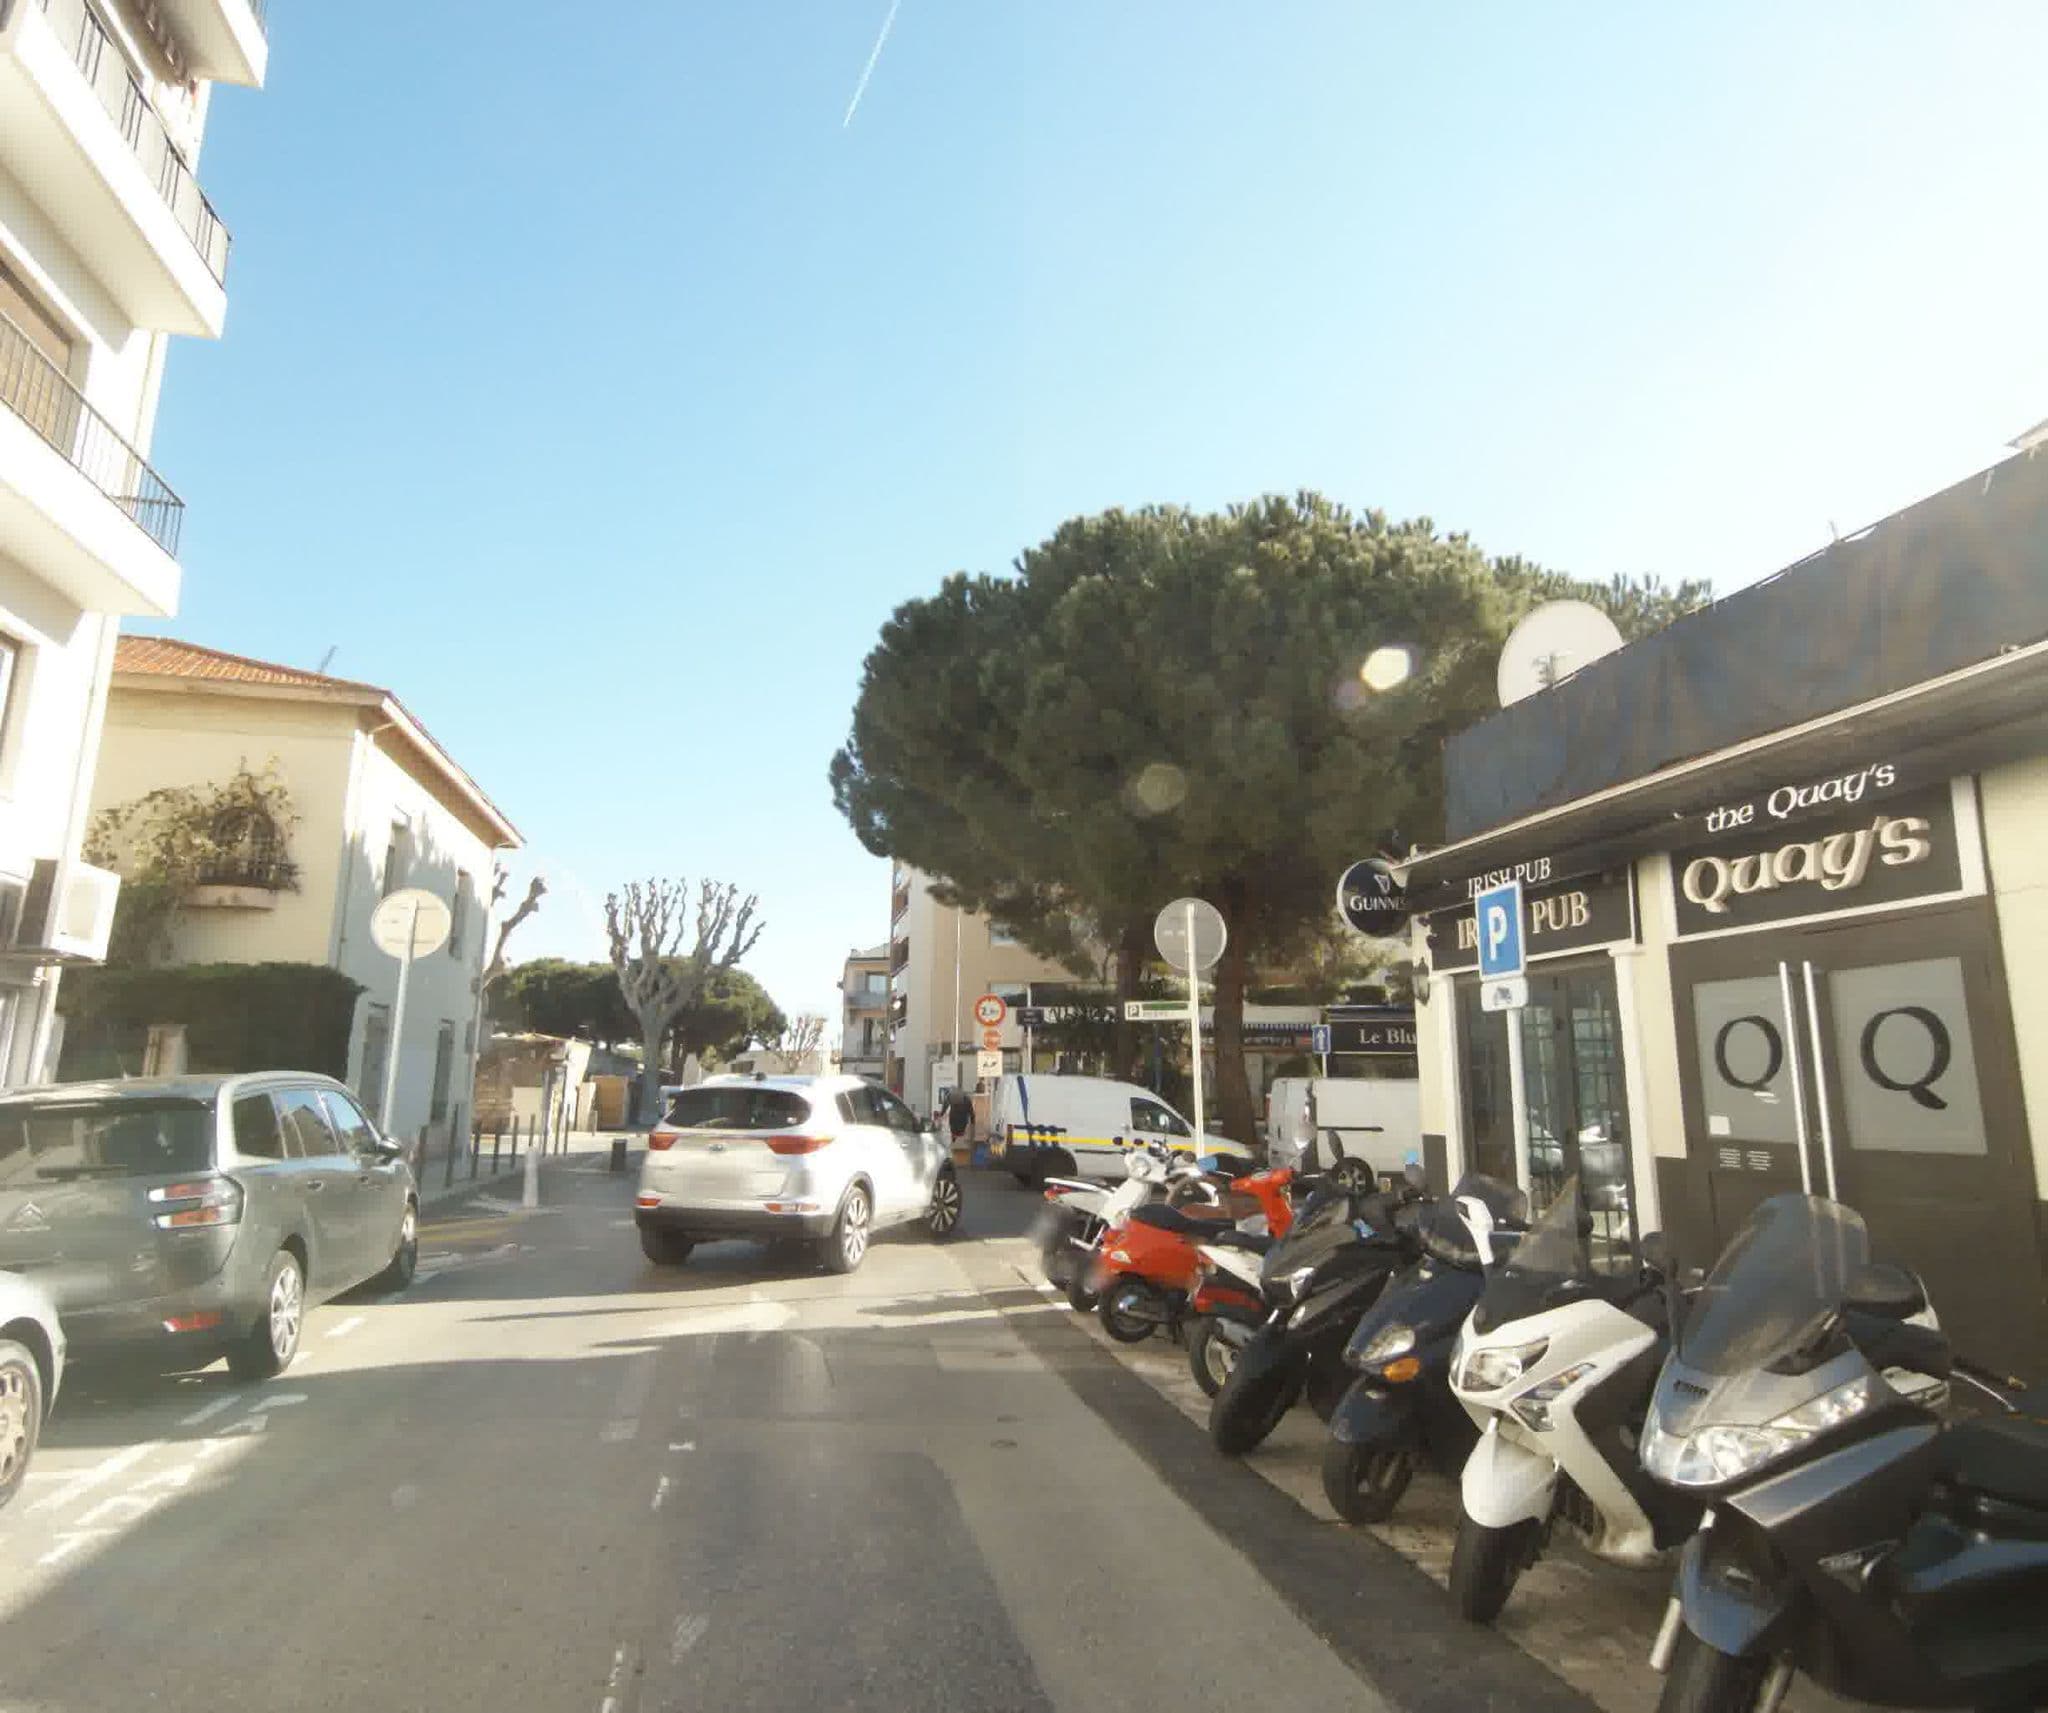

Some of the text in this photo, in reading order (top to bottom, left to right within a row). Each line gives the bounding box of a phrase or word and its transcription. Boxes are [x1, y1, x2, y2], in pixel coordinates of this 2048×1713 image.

[1705, 763, 1895, 833] the Quay's
[1467, 857, 1551, 899] IRISH PUB
[1682, 815, 1931, 914] Quay's
[1487, 905, 1508, 961] P
[1531, 891, 1591, 934] PUB
[1358, 1028, 1380, 1044] Le
[1860, 1006, 1951, 1110] Q
